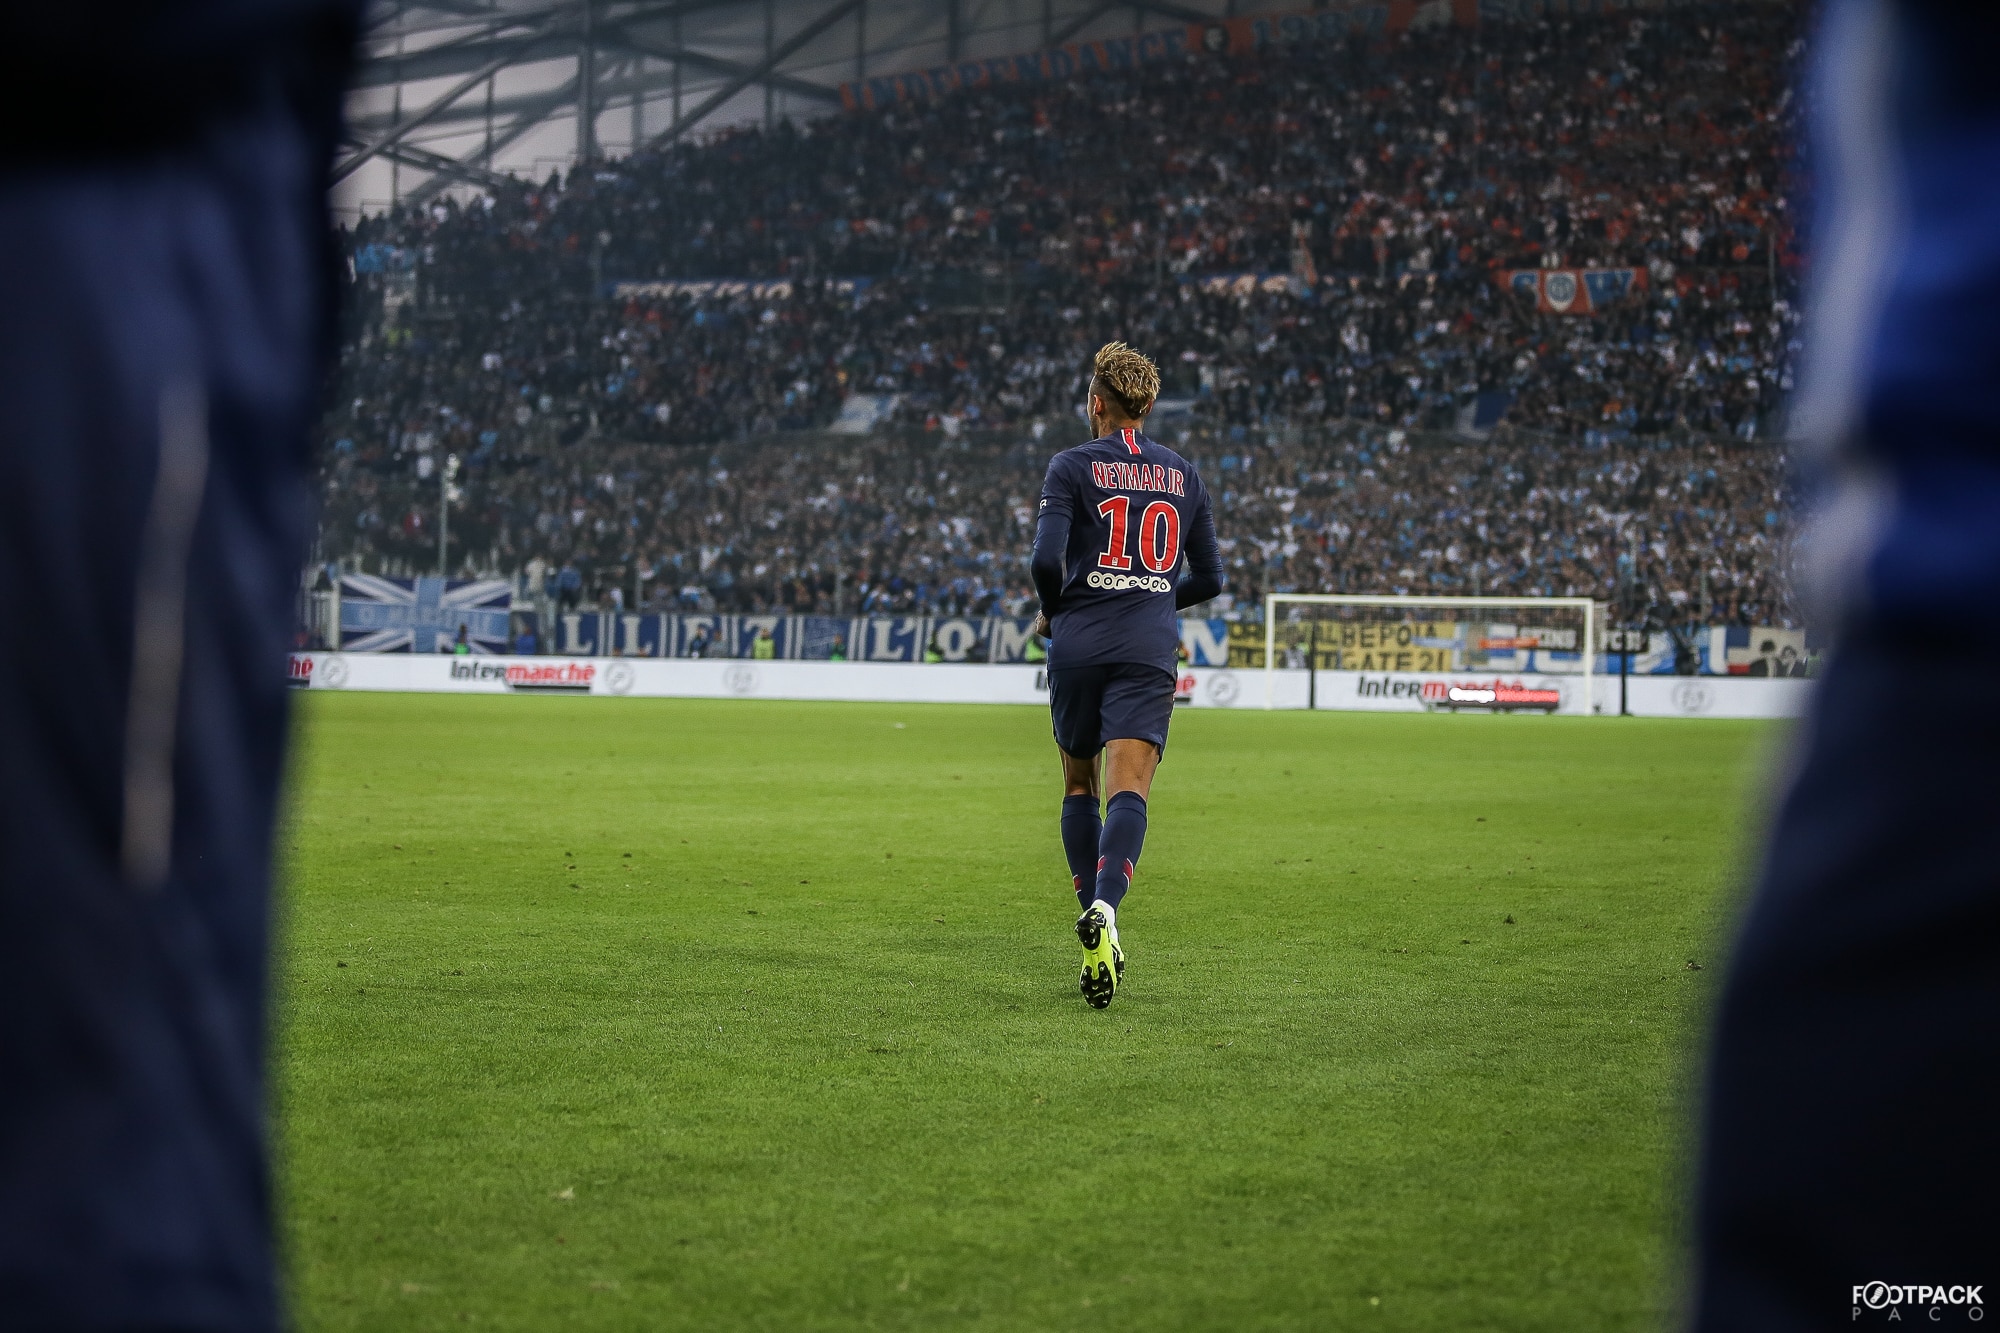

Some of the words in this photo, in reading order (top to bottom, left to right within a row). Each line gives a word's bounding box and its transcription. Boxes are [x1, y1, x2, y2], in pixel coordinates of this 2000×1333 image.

[1092, 461, 1165, 492] NEYMAR
[1168, 467, 1185, 497] JR
[1096, 495, 1181, 573] 10
[1087, 571, 1172, 593] ooredoo
